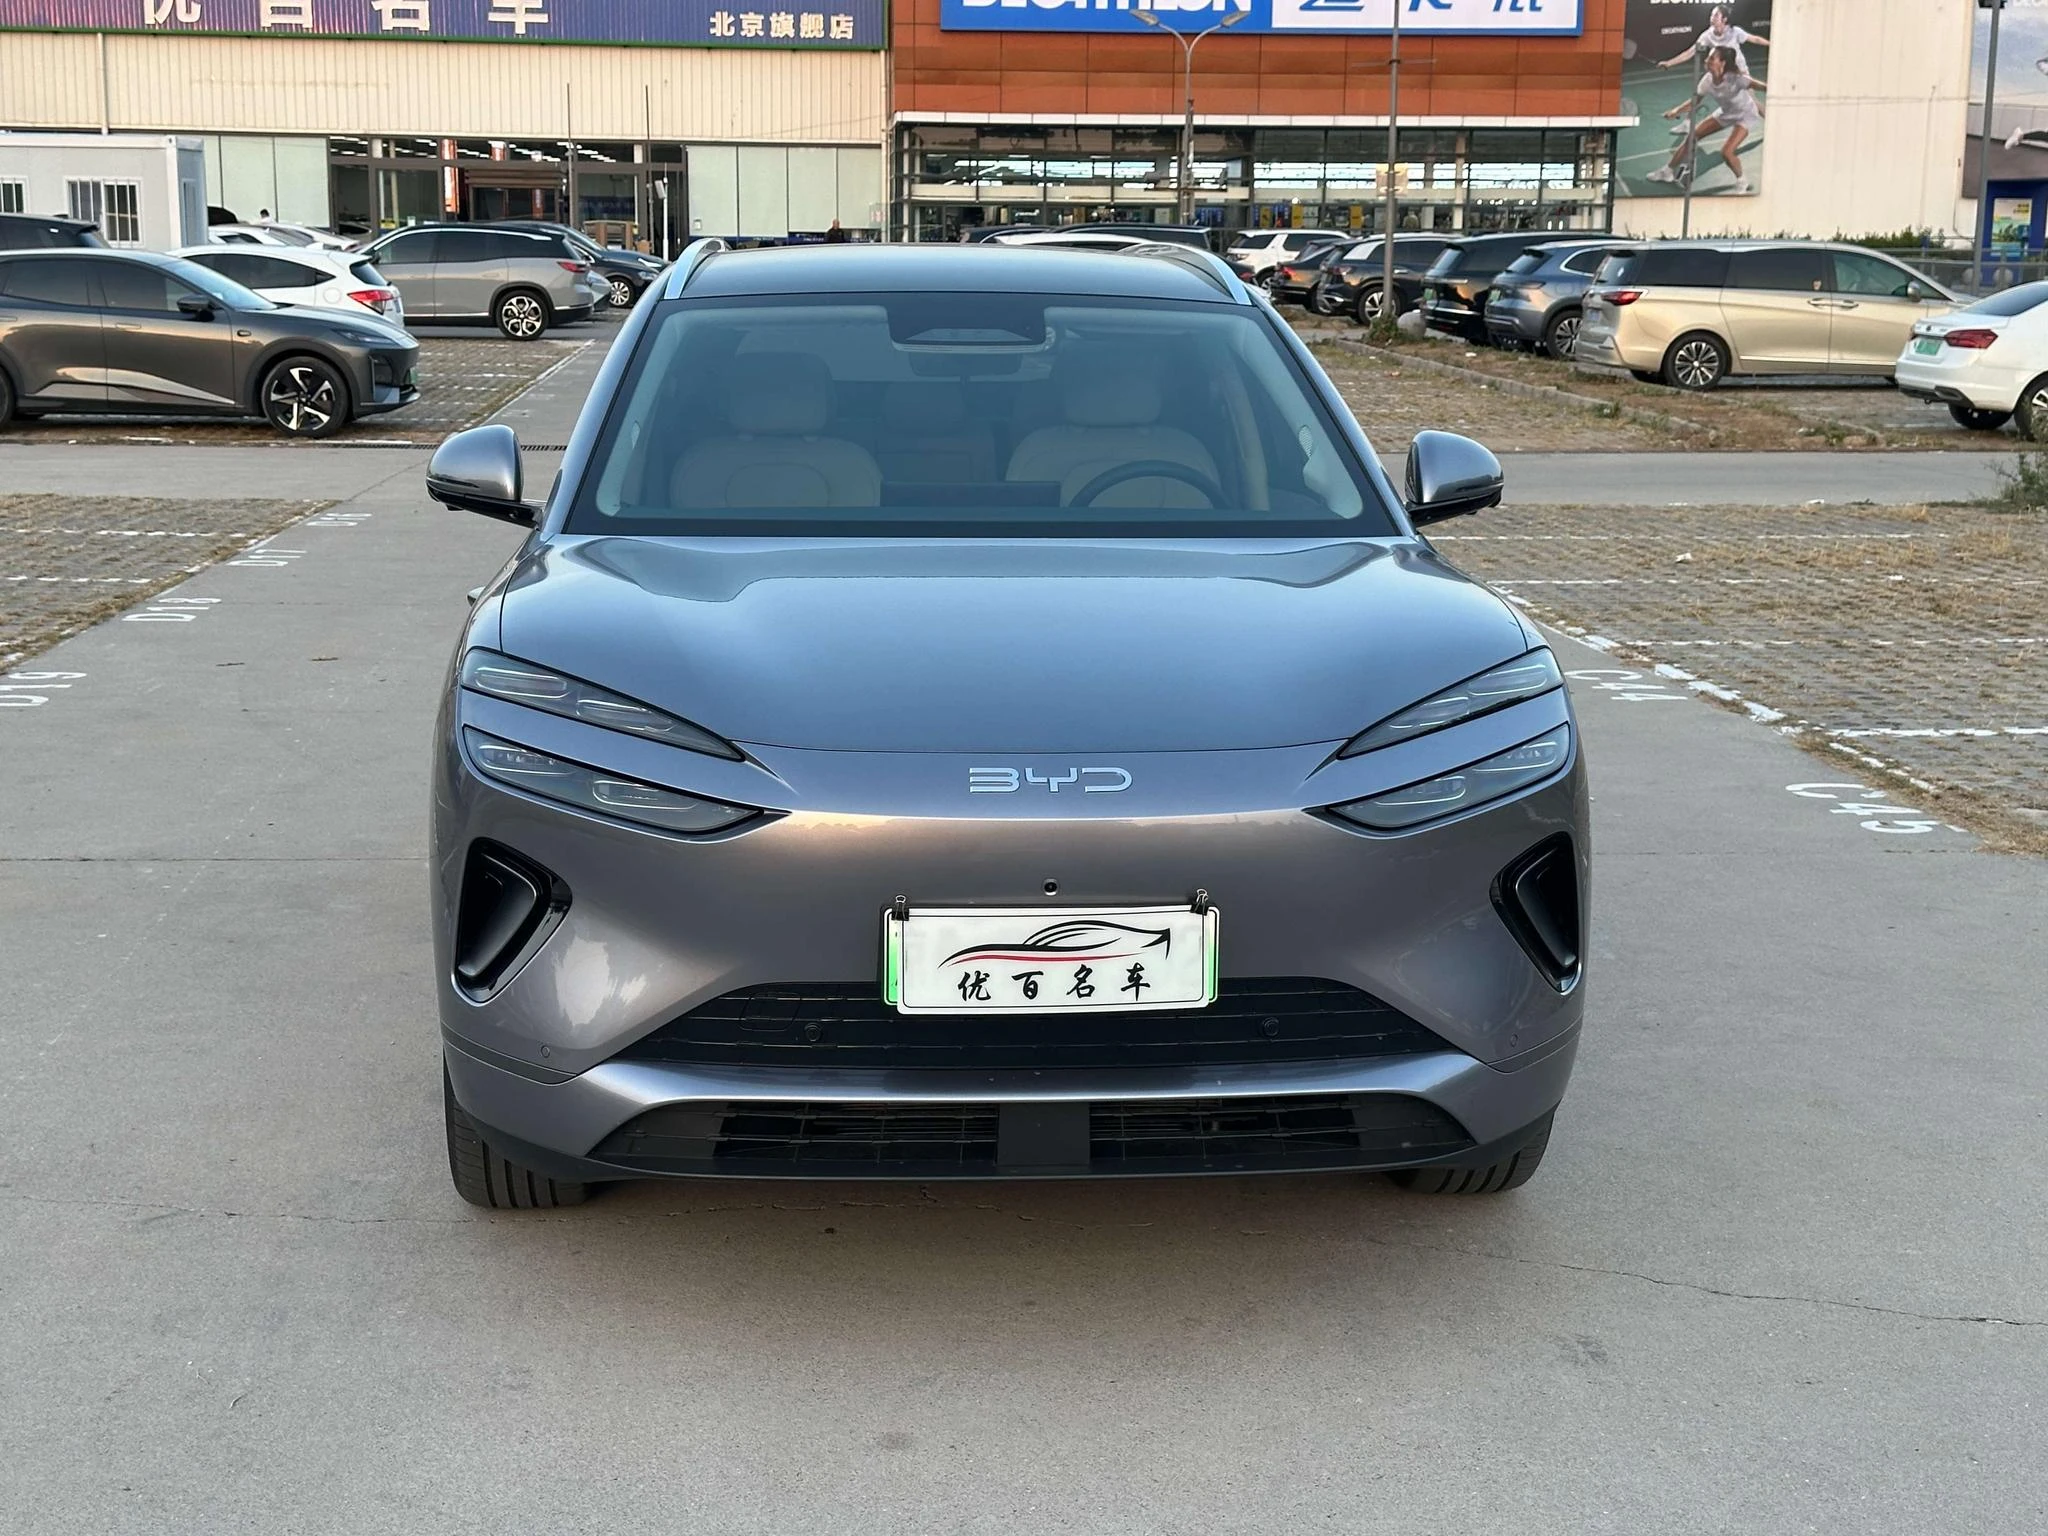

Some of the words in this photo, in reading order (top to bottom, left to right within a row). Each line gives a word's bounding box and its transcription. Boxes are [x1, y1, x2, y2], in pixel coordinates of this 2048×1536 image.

[709, 11, 854, 40] 北京旗舰店
[227, 548, 307, 567] D17
[122, 597, 222, 623] D18
[0, 671, 87, 707] D19
[1564, 669, 1689, 702] C44
[968, 767, 1133, 793] BYD
[1785, 782, 1968, 835] C45
[957, 962, 1151, 1002] 优百名车
